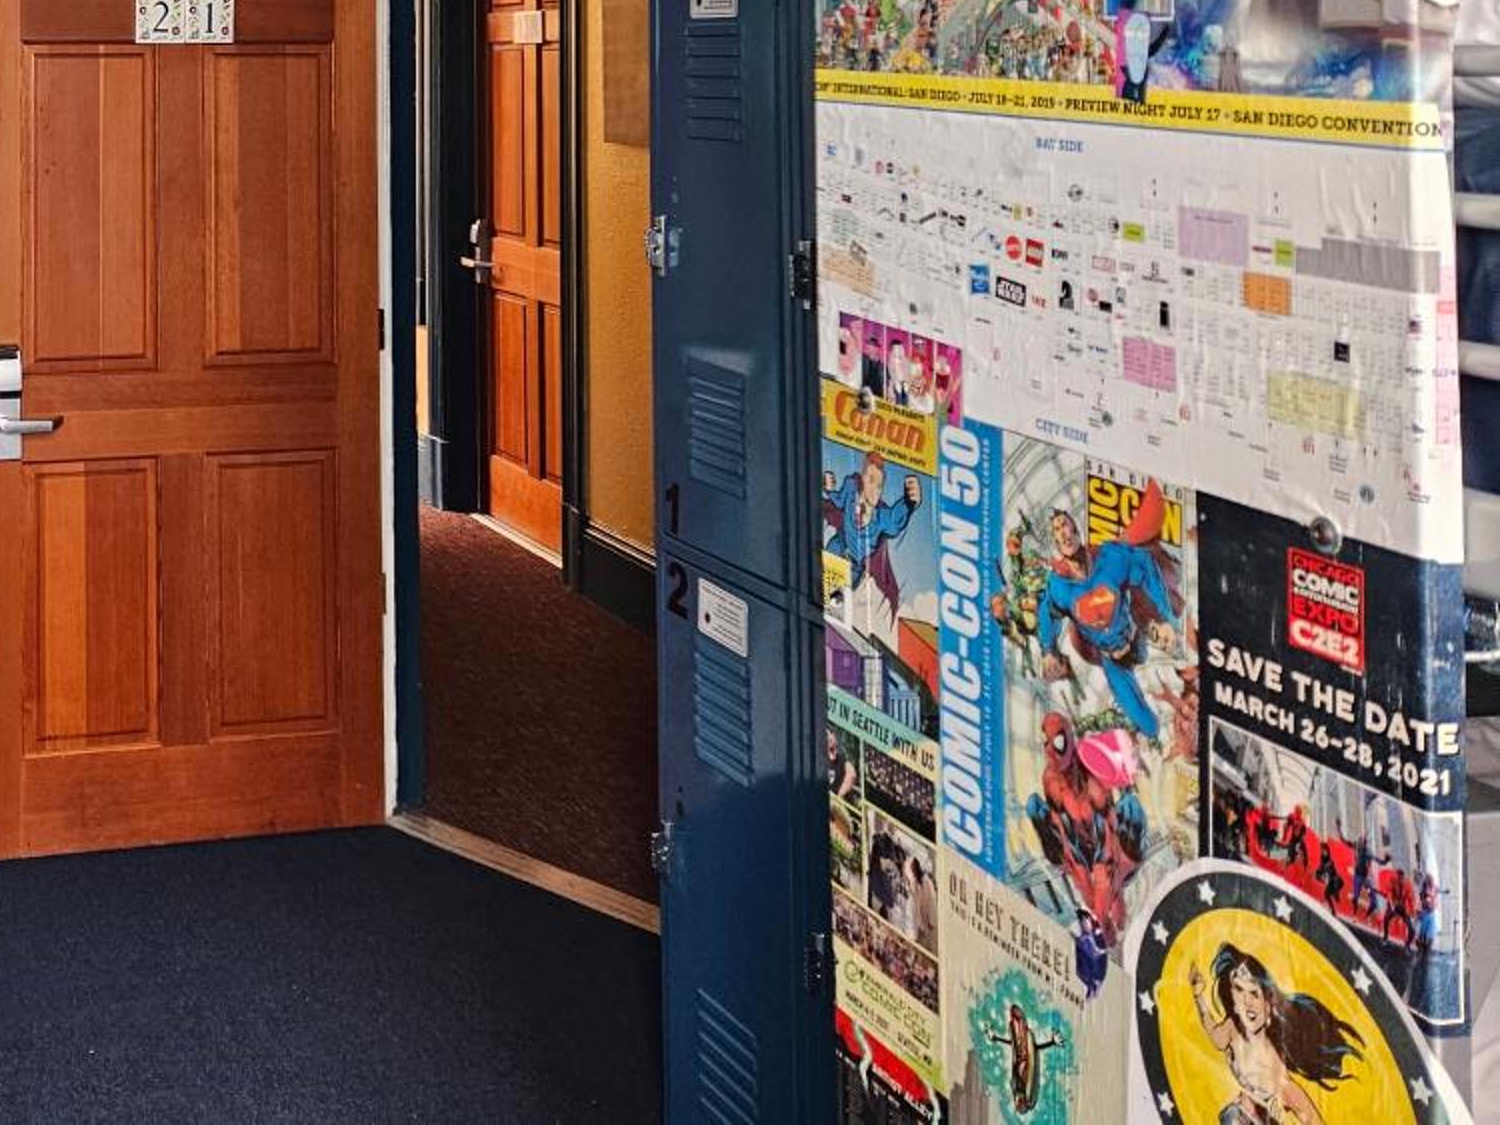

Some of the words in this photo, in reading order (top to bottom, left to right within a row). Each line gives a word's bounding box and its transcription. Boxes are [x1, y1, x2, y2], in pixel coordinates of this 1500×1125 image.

[929, 89, 961, 102] DIEGO
[968, 92, 993, 105] JULY
[1066, 98, 1121, 114] PREVIEW
[1124, 102, 1166, 118] NIGHT
[1169, 105, 1202, 120] JULY
[1207, 108, 1220, 120] 17
[1233, 109, 1263, 124] SAN
[1268, 112, 1318, 129] DIEGO
[1322, 116, 1444, 137] CONVENTION
[835, 390, 926, 453] Conan
[939, 425, 980, 507] 50
[666, 483, 679, 535] 1
[1121, 488, 1181, 544] CN
[667, 562, 688, 619] 2
[1293, 568, 1359, 603] COMIC
[1293, 596, 1359, 634] EXPO
[1291, 618, 1359, 667] C2E2
[940, 511, 982, 856] COMIC-CON
[1207, 638, 1283, 694] SAVE
[1291, 671, 1355, 723] THE
[1365, 700, 1459, 756] DATE
[840, 702, 850, 721] IN
[852, 710, 889, 745] SEATTLE
[892, 732, 918, 762] WITH
[921, 748, 935, 771] US
[1214, 680, 1295, 735] MARCH
[1301, 718, 1383, 777] 26-28,
[1387, 756, 1451, 796] 2021
[975, 890, 1003, 931] HEY
[1010, 915, 1070, 982] THERE!
